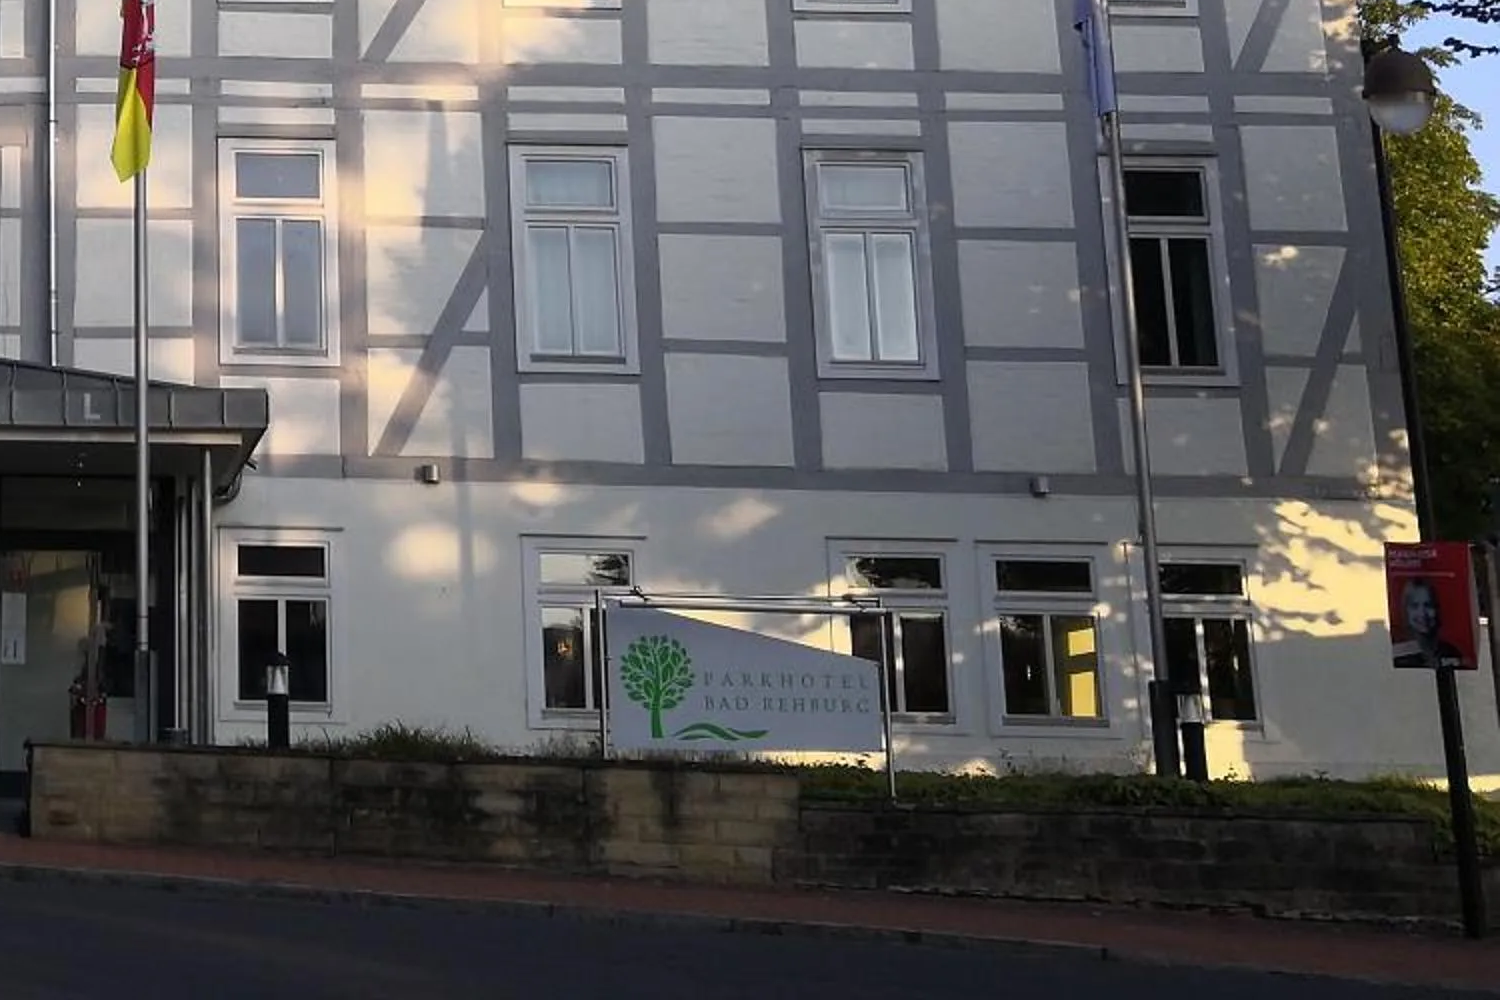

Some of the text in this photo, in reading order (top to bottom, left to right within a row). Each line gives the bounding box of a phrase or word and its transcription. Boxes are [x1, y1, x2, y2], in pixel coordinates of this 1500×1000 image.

[703, 671, 870, 690] PARKHOTEL
[704, 696, 870, 713] BAD REHBURG
